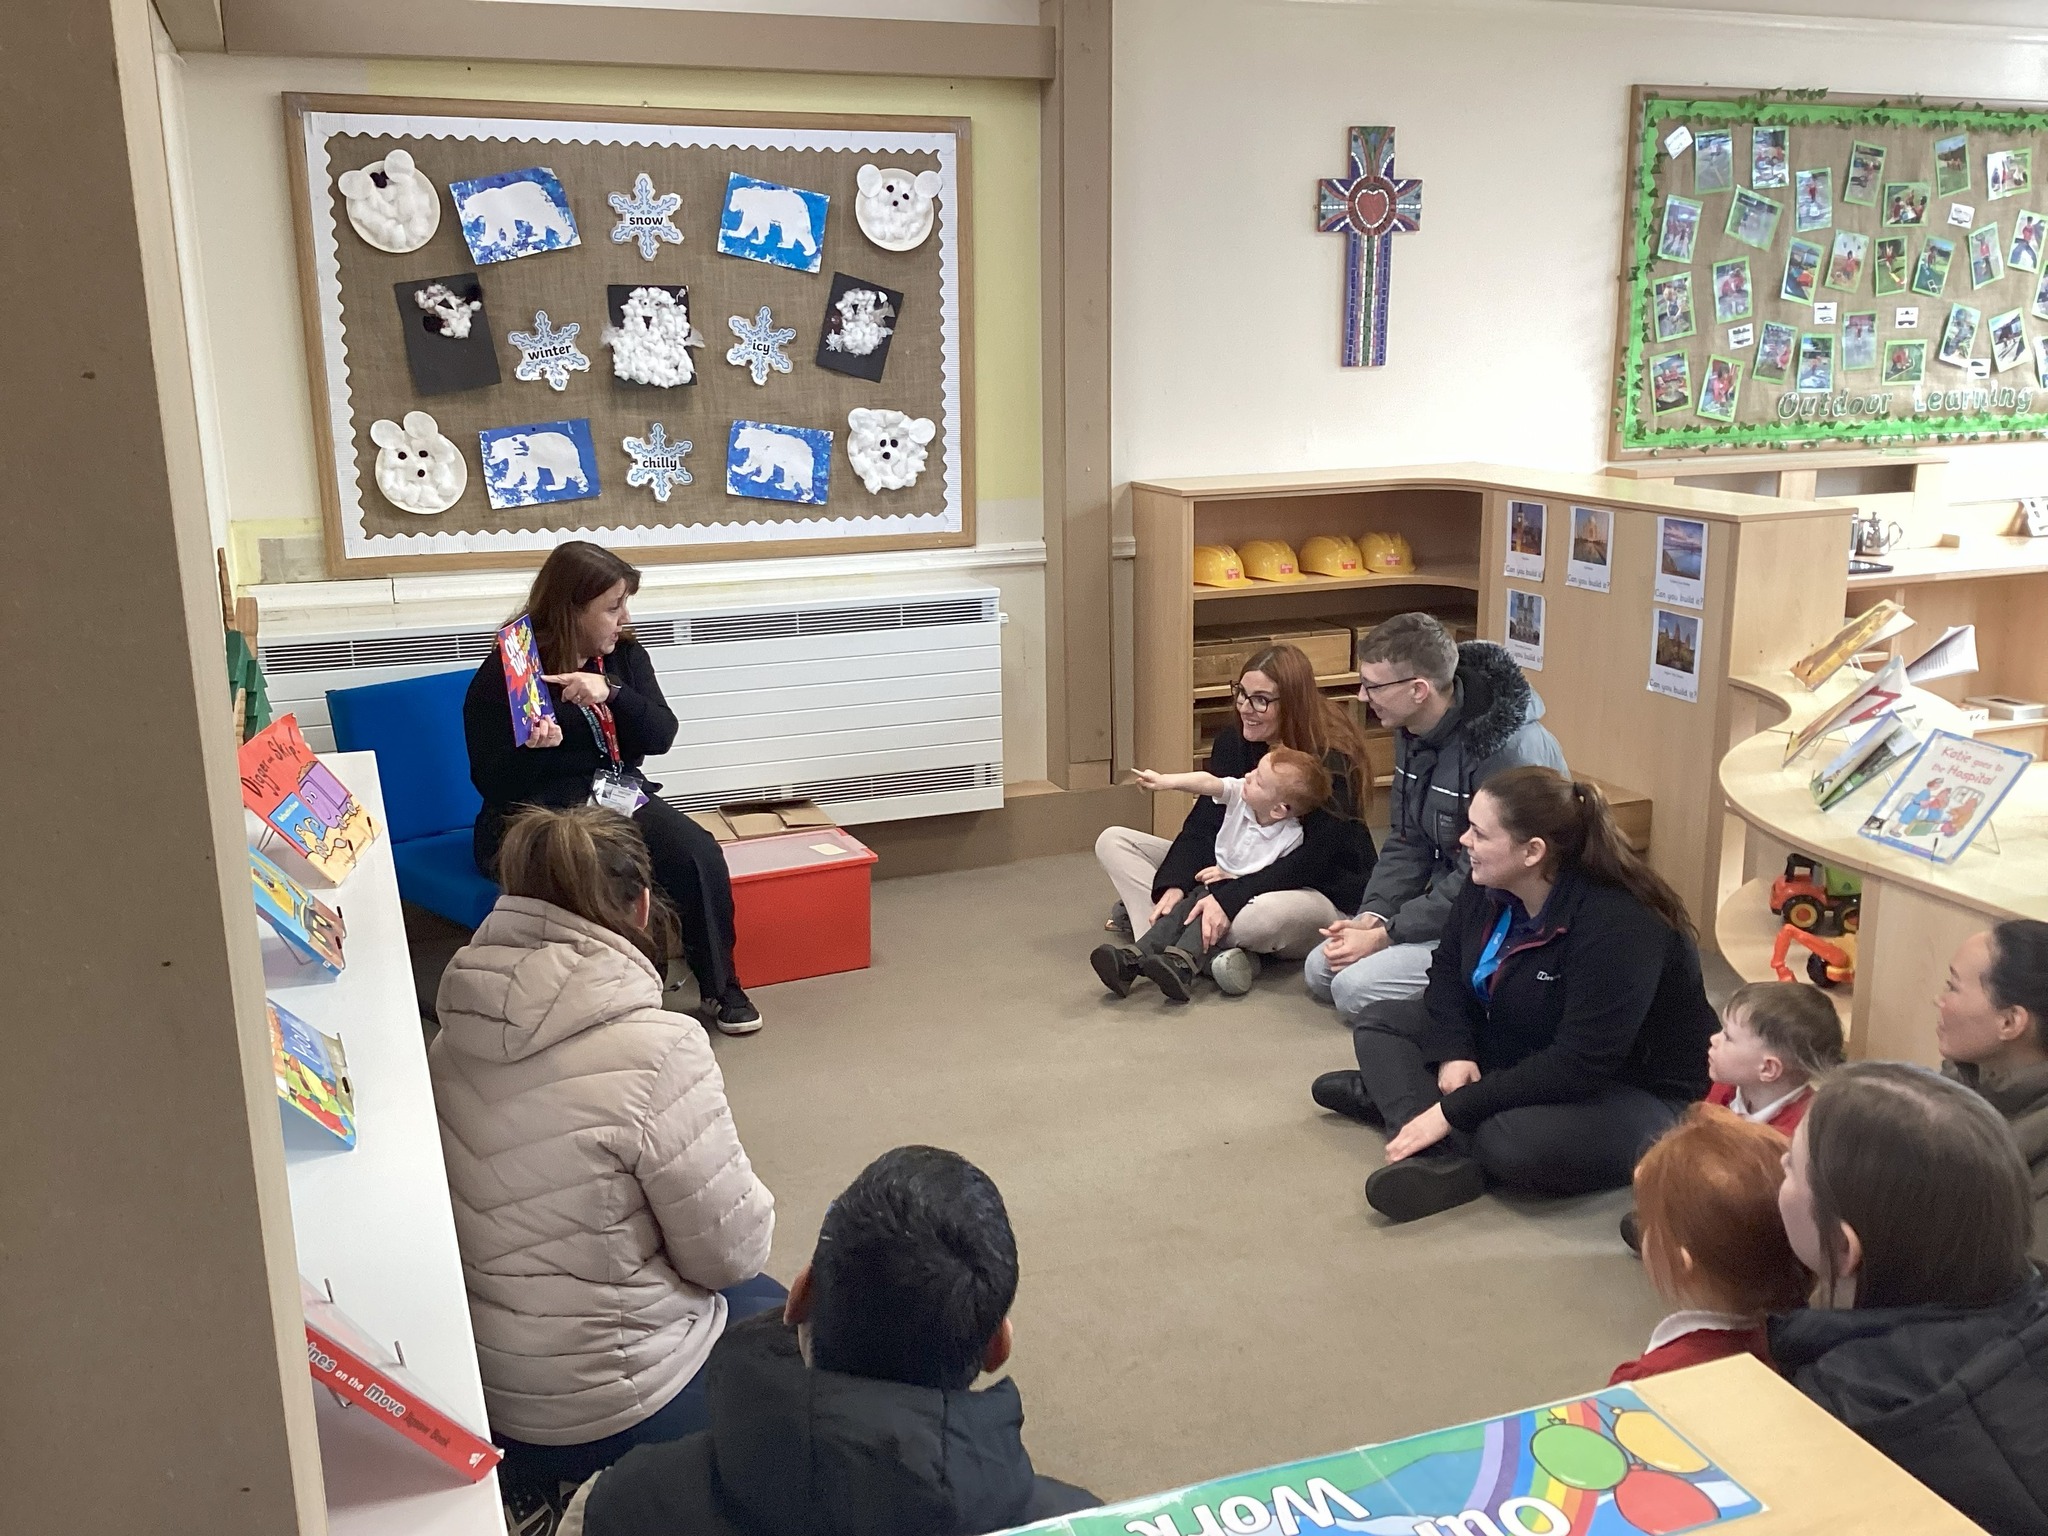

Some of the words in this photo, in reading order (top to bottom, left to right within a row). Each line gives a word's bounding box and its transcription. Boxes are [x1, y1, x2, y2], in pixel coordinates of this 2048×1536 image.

[629, 215, 664, 226] snow
[527, 343, 573, 361] winter
[752, 340, 771, 355] icy
[1777, 388, 1893, 419] Outdoor
[1913, 379, 2034, 414] Learning
[642, 456, 677, 471] chilly
[1655, 588, 1666, 598] Can
[1667, 593, 1679, 602] you
[1680, 593, 1695, 604] build
[1650, 678, 1660, 688] Can
[1661, 684, 1672, 693] you
[1673, 685, 1687, 697] build
[240, 759, 280, 798] Digger
[267, 726, 302, 764] Skip!
[1941, 745, 1972, 763] Katie
[1994, 763, 2005, 772] to
[1946, 763, 1998, 785] Hospital
[307, 1342, 335, 1373] ines
[334, 1369, 348, 1381] on
[348, 1376, 365, 1391] the
